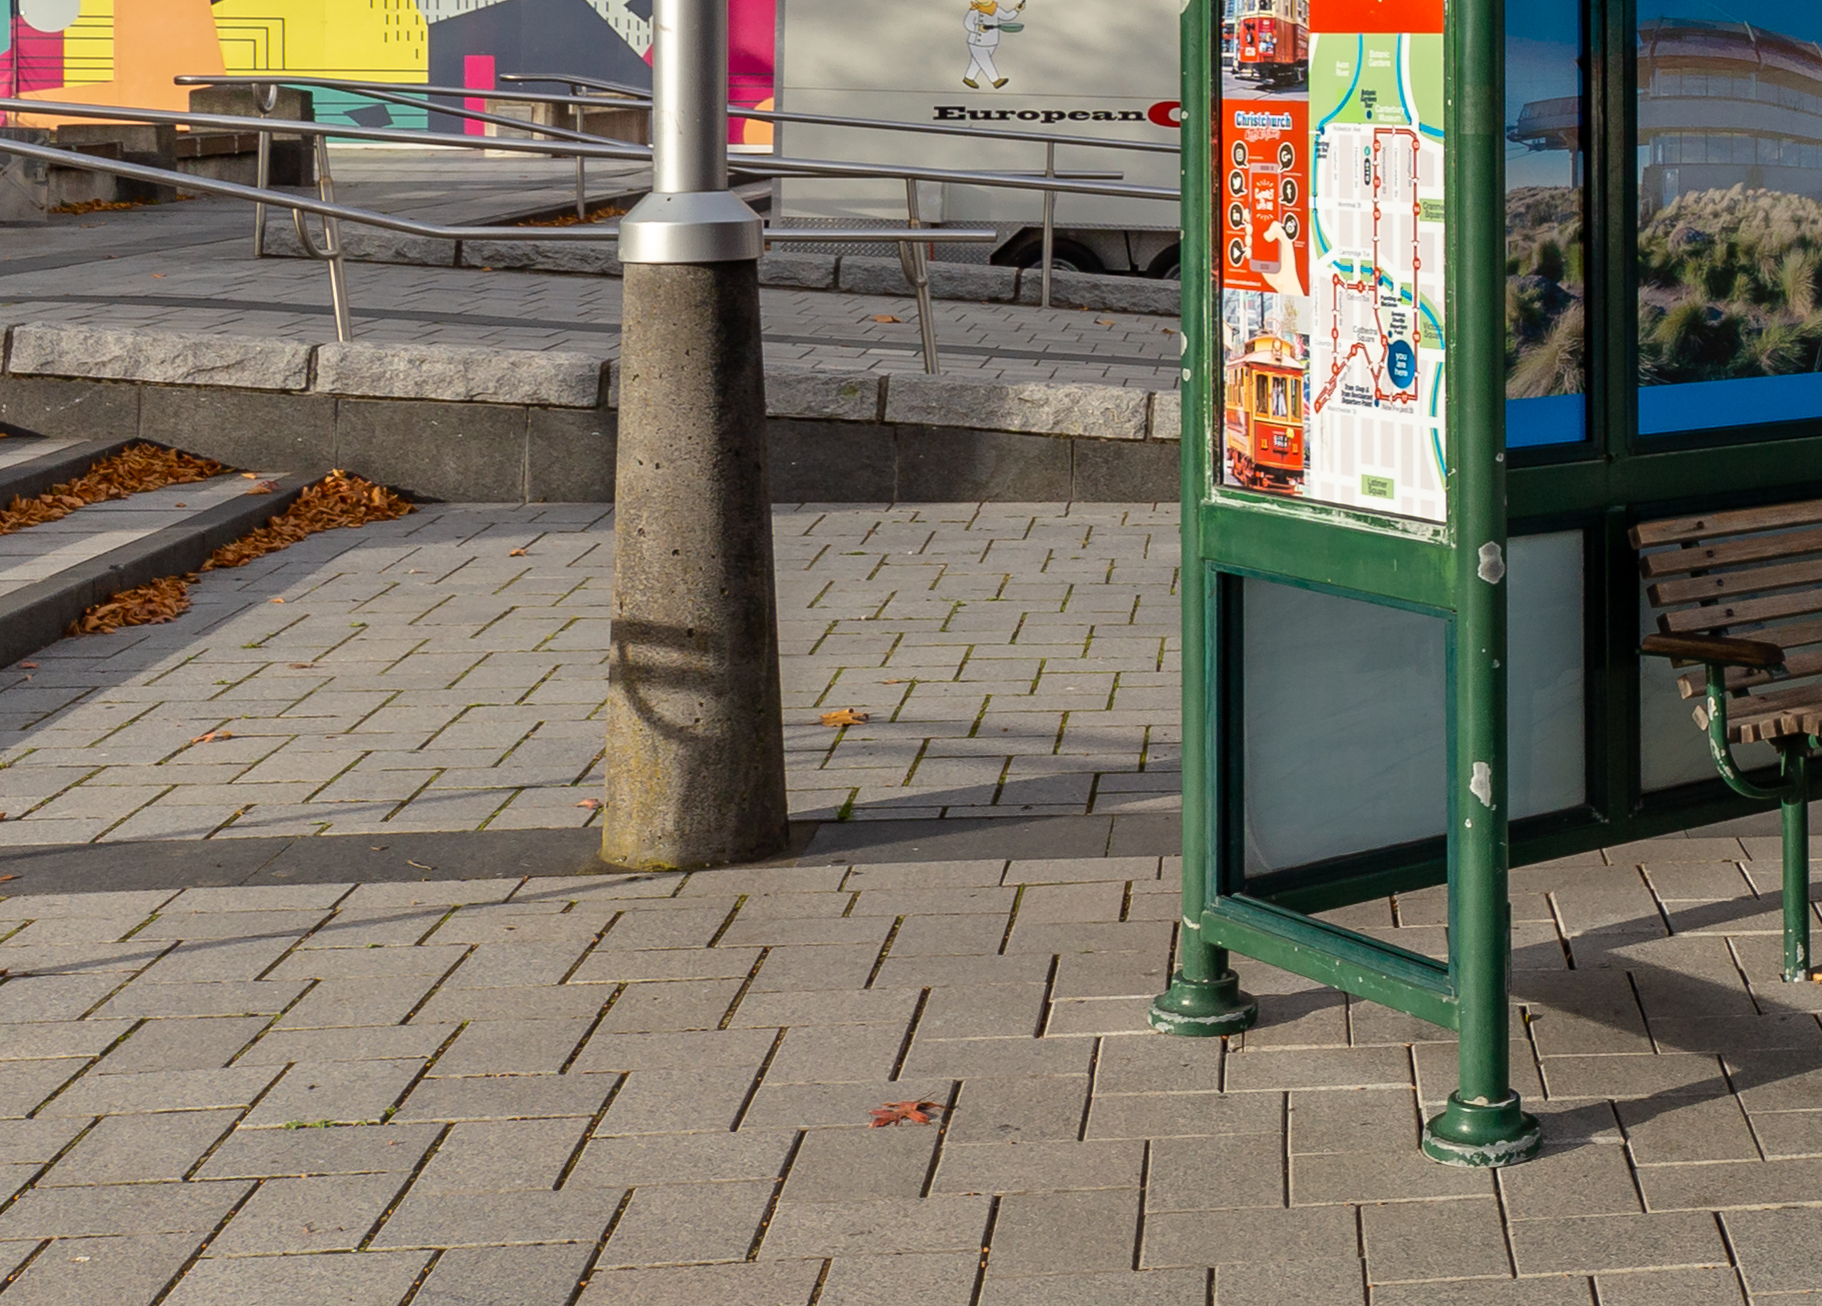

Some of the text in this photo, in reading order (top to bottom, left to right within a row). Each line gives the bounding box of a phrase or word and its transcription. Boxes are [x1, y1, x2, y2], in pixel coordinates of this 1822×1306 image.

[932, 106, 1147, 124] European
[1235, 110, 1293, 131] Christchurch
[1395, 352, 1408, 362] you
[1396, 361, 1408, 369] are
[1395, 367, 1409, 377] here
[1367, 478, 1388, 488] Latimer
[1367, 486, 1388, 497] Square
